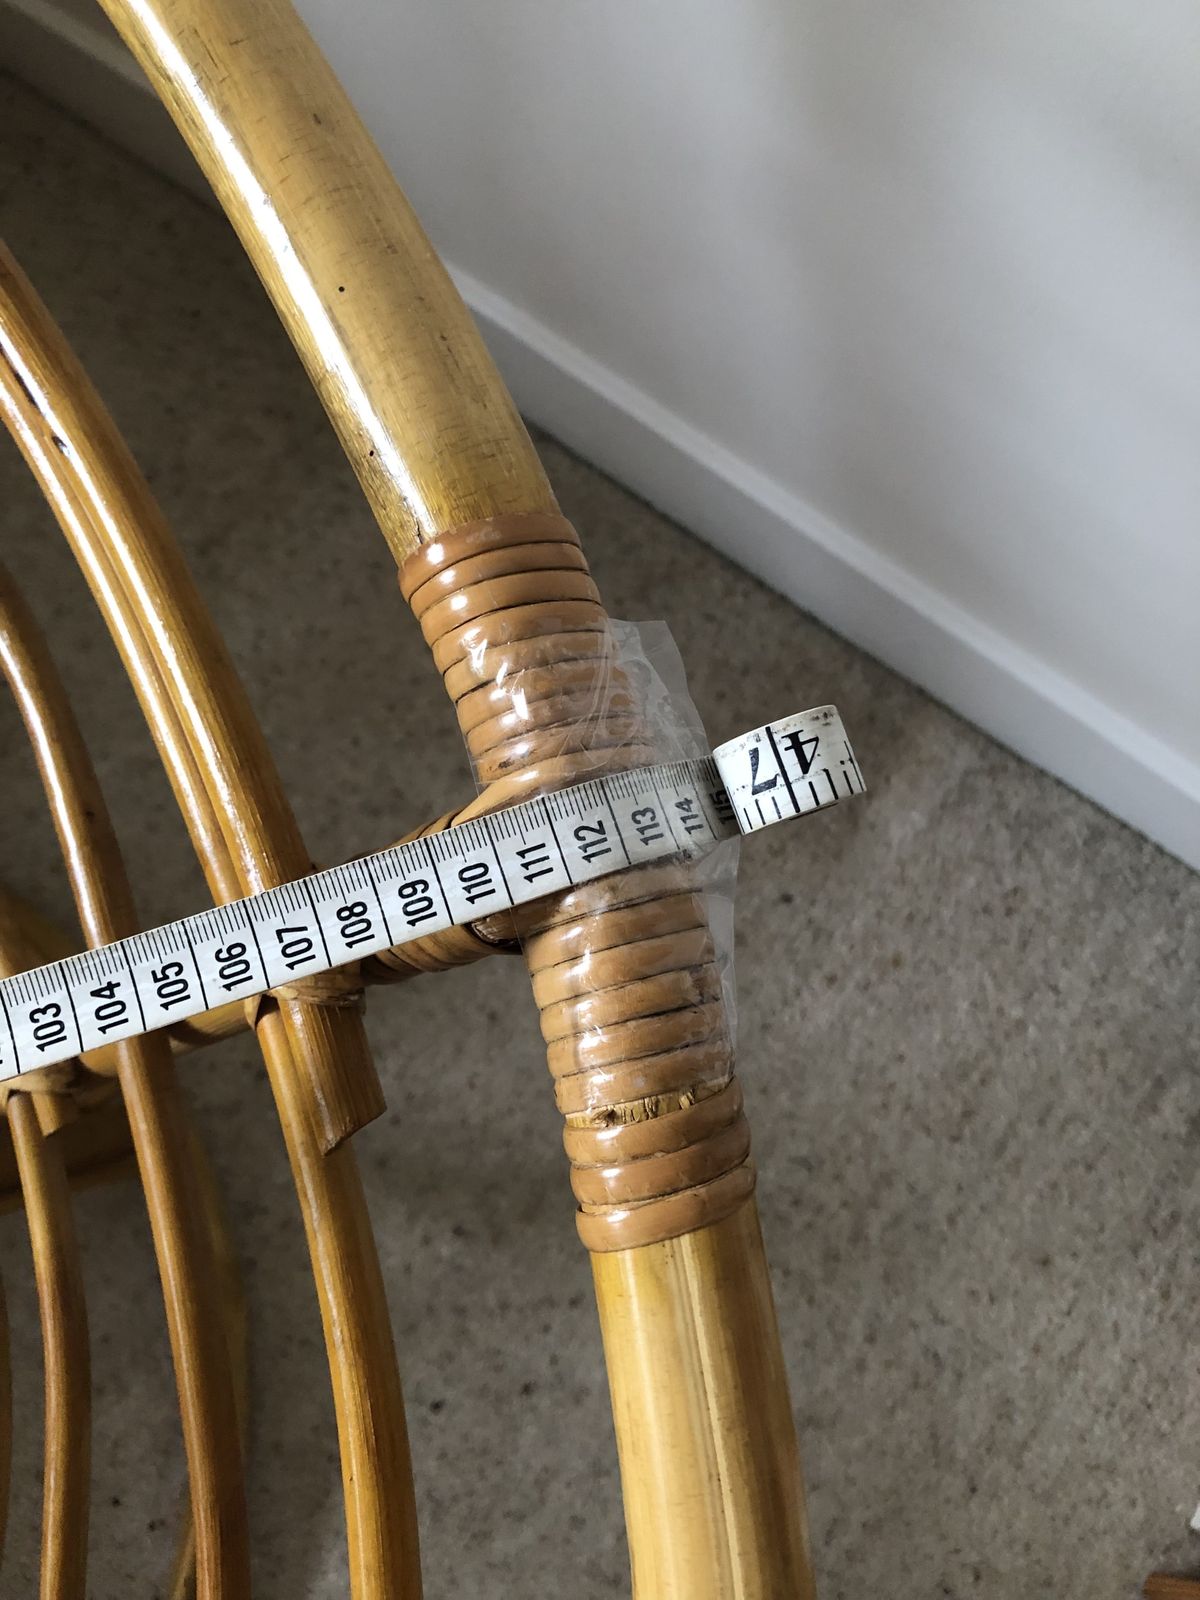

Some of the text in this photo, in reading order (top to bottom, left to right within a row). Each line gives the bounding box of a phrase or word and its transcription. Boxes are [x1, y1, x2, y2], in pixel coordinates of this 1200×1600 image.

[29, 1002, 67, 1052] 103
[90, 981, 129, 1034] 104
[151, 961, 191, 1011] 105
[214, 942, 253, 992] 106
[275, 925, 316, 970] 107
[336, 900, 375, 949] 108
[398, 878, 437, 927] 109
[458, 862, 496, 904] 110
[515, 842, 554, 883] 111
[573, 820, 612, 863] 112
[631, 807, 664, 846] 113
[675, 797, 704, 835] 114
